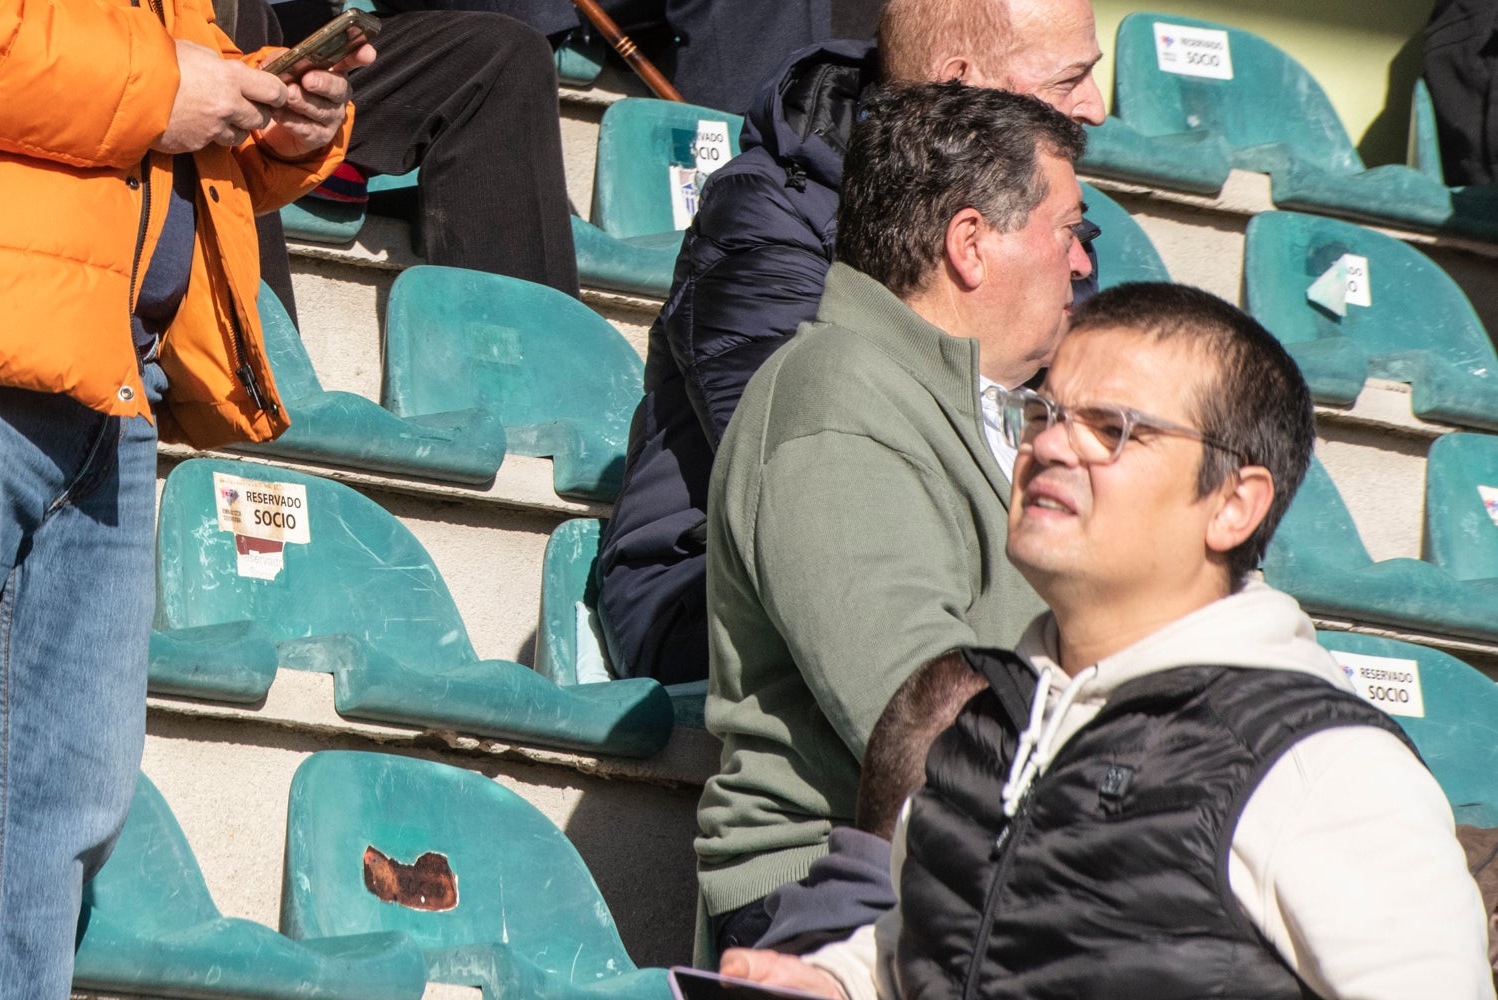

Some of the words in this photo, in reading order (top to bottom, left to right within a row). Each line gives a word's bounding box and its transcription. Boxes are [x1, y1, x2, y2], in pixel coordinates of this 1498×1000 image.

[245, 490, 302, 509] RESERVADO
[253, 508, 297, 530] SOCIO
[1360, 667, 1413, 684] RESERVADO
[1368, 685, 1409, 703] SOCIO
